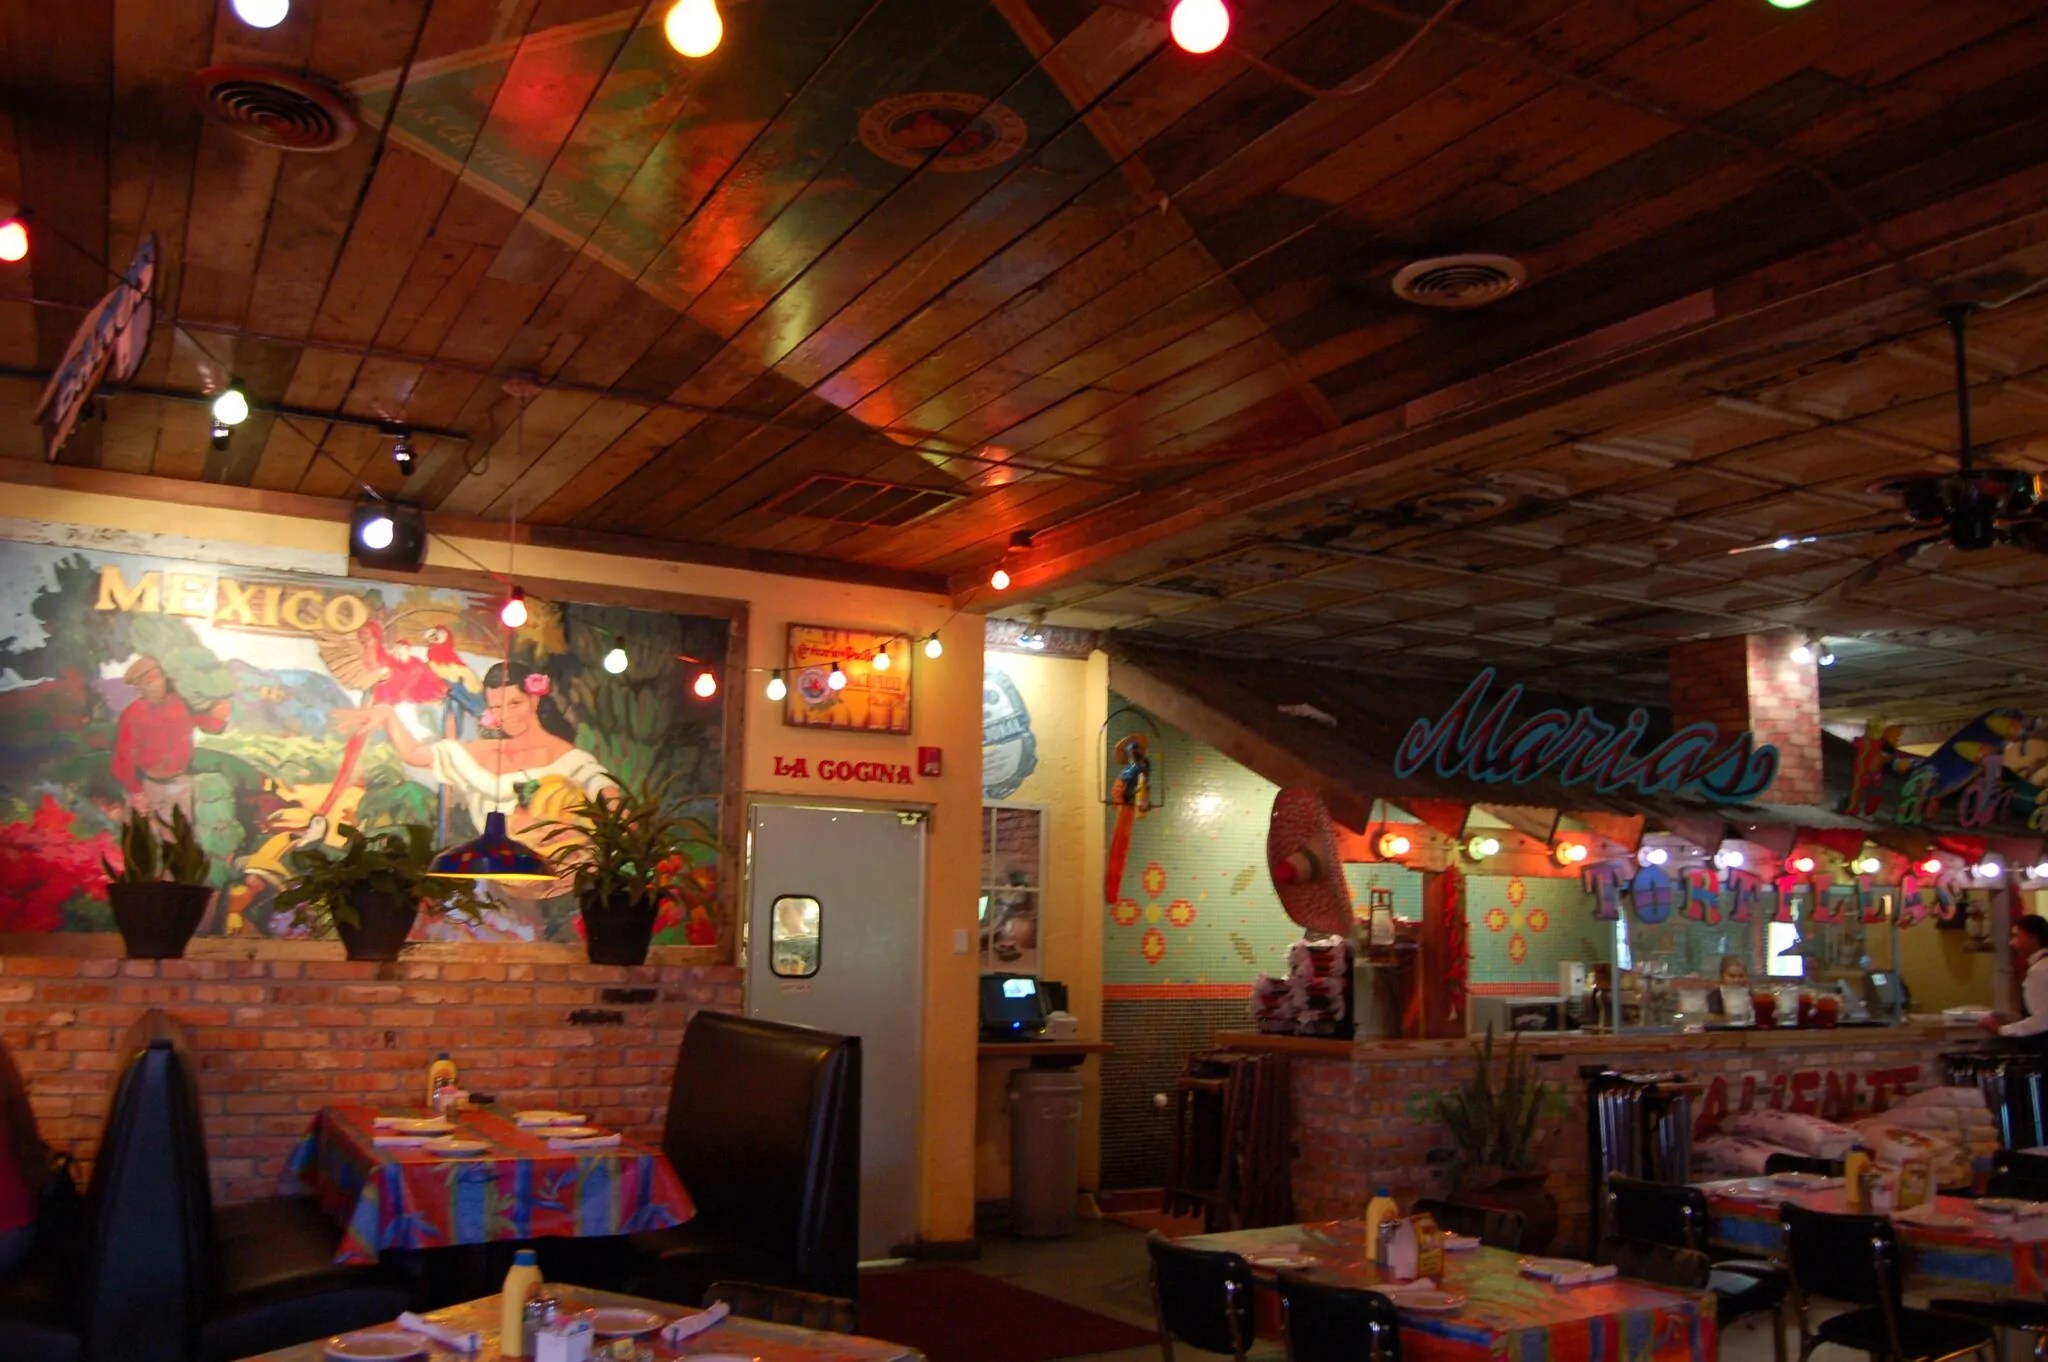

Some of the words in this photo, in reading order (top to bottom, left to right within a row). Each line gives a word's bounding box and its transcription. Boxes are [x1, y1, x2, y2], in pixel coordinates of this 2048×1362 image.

[94, 565, 370, 633] MEXICO
[773, 756, 810, 778] LA
[1583, 861, 1962, 928] TORTILLAS
